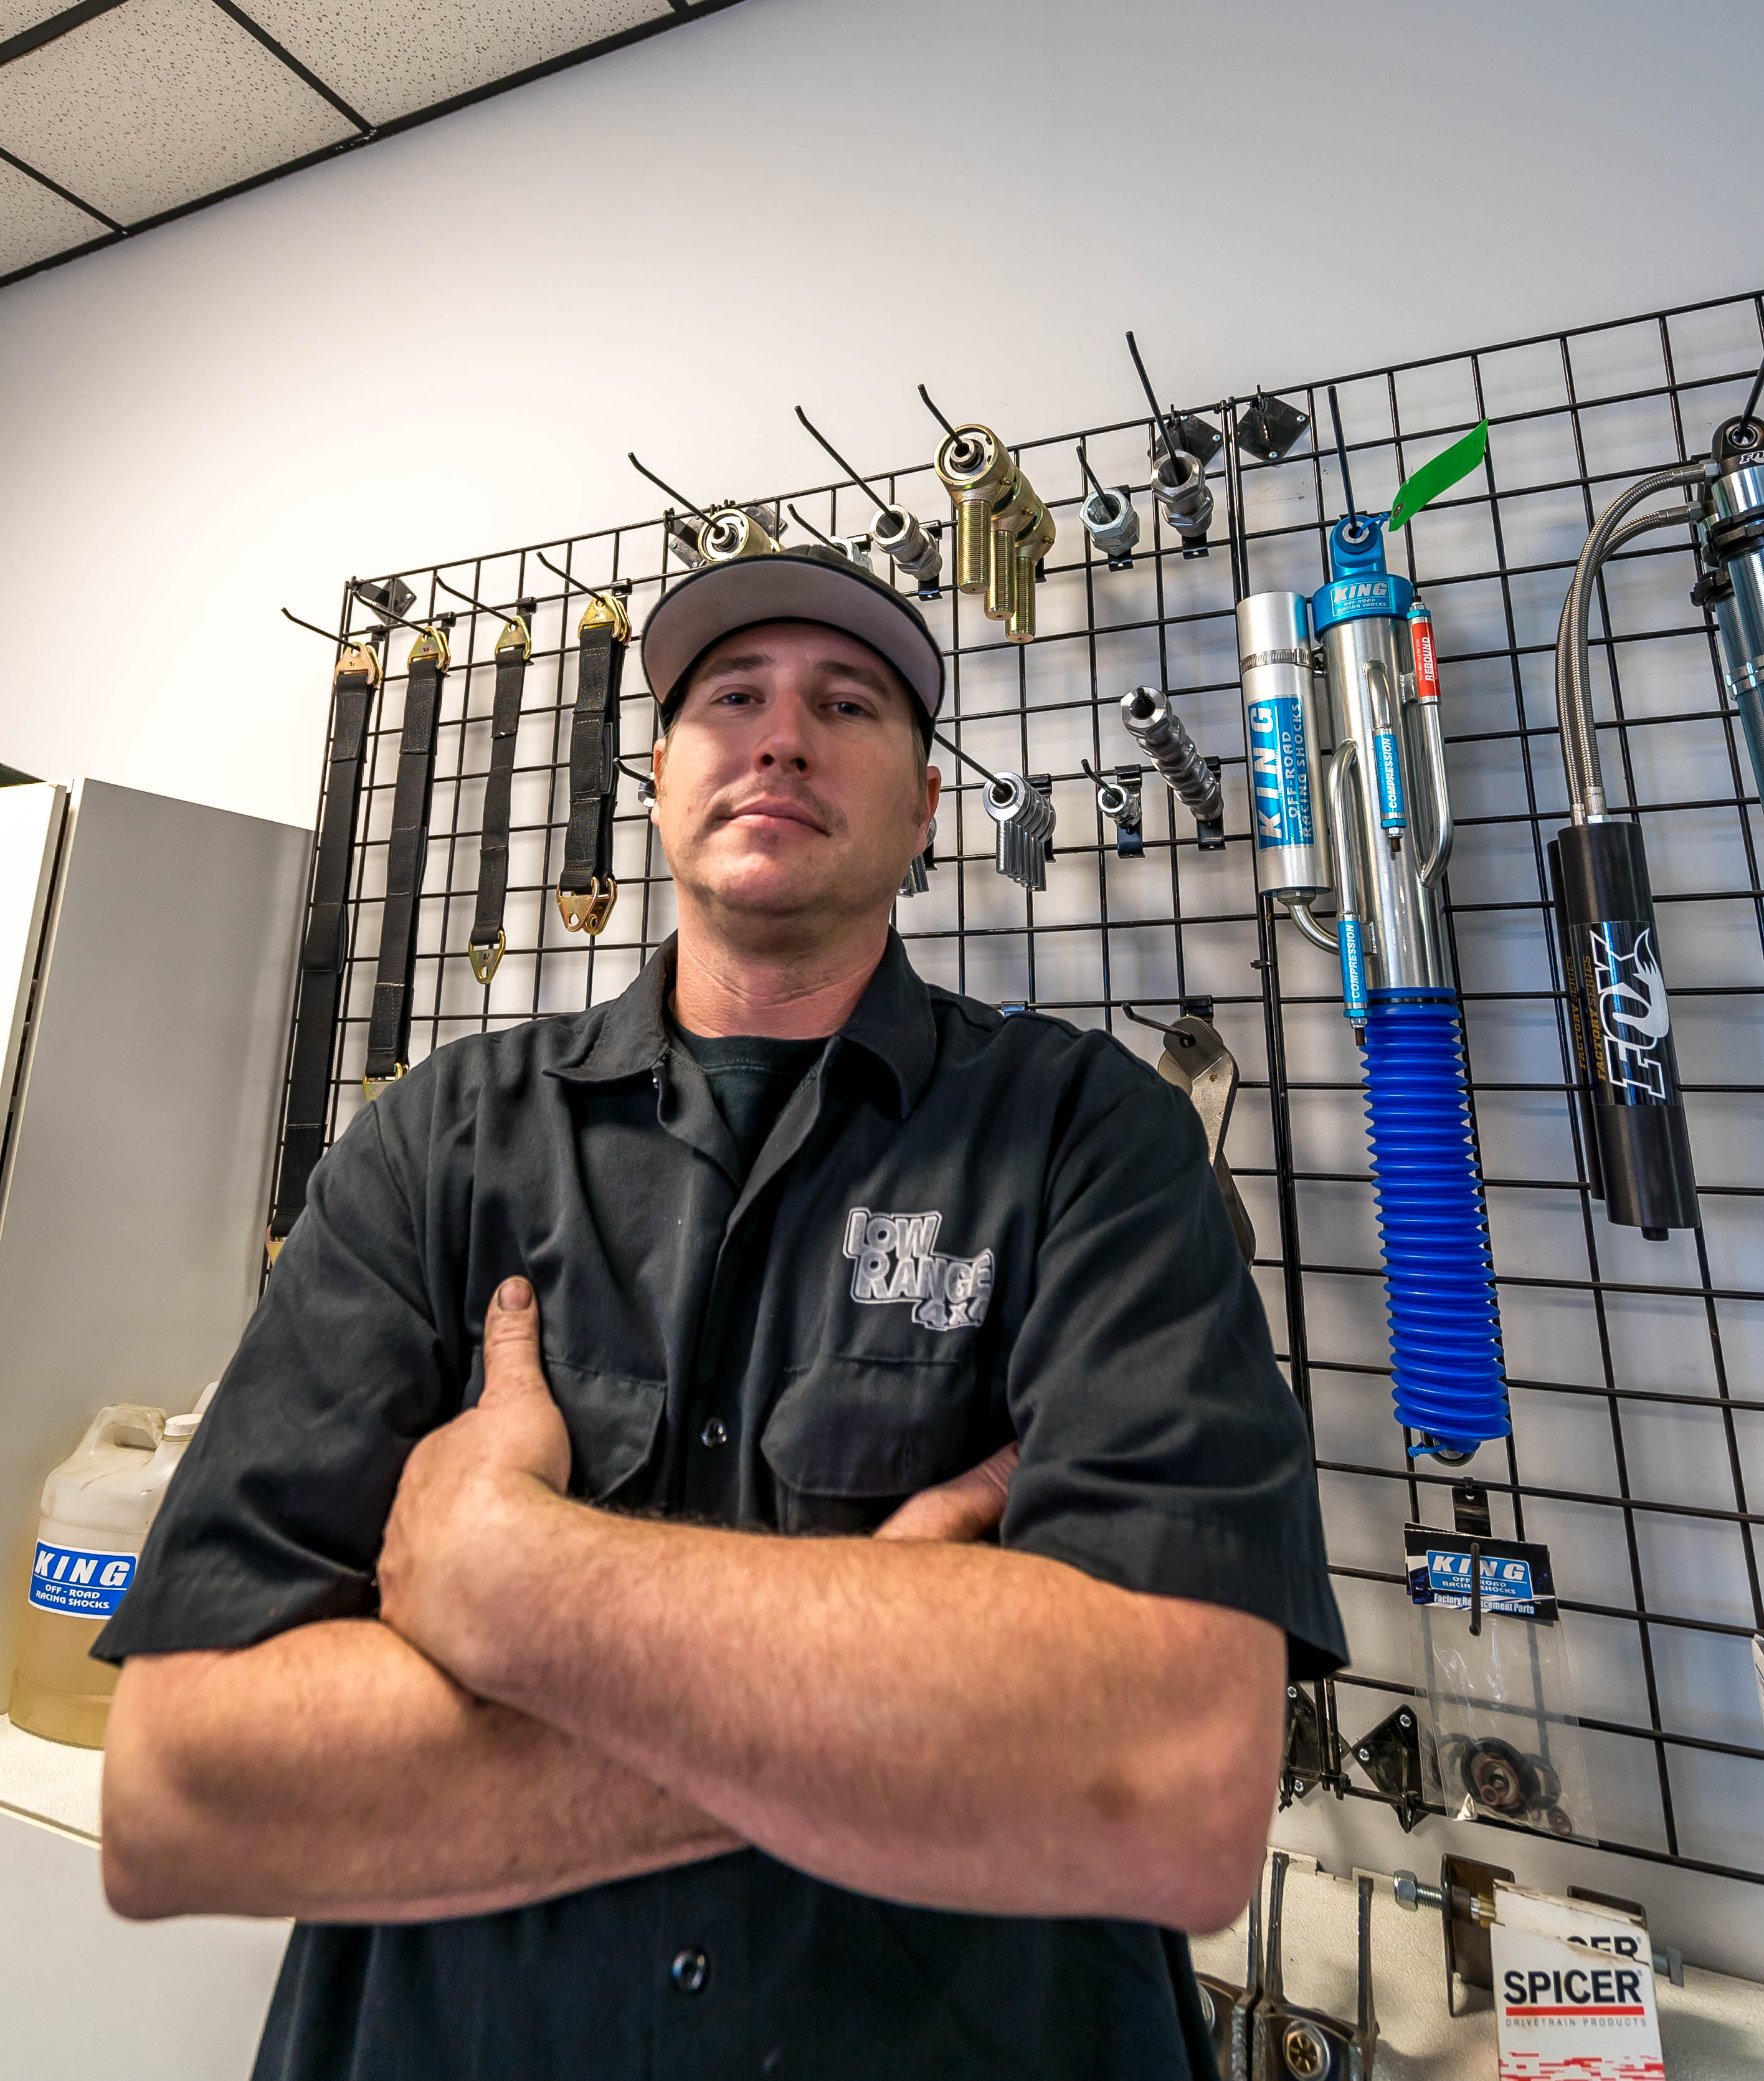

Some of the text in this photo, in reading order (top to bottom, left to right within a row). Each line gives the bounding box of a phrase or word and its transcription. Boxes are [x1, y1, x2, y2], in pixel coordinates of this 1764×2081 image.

[1739, 450, 1764, 465] FO
[1334, 583, 1387, 603] KING
[1422, 637, 1434, 681] REBOUND
[1251, 707, 1283, 839] KING
[1282, 731, 1298, 819] OFF-ROAD
[1291, 703, 1312, 838] RACING SHOCKS
[1383, 738, 1398, 809] COMPRESSION
[1345, 925, 1360, 998] COMPRESSION
[1566, 956, 1586, 1070] FACTORY SERIES
[1583, 955, 1606, 1081] FACTORY SERIES
[1590, 928, 1669, 1100] FOX
[847, 1211, 938, 1259] LOW
[855, 1250, 992, 1304] RANGE
[35, 1550, 130, 1586] KING
[1432, 1555, 1525, 1581] KING
[1442, 1581, 1471, 1589] RACIN
[36, 1590, 110, 1609] RACING SHOCKS
[1434, 1593, 1462, 1607] Factory
[1514, 1603, 1535, 1614] Parts
[1504, 1969, 1642, 2004] SPICER
[1506, 2017, 1648, 2027] DRIVETRAIN PRODUCTS
